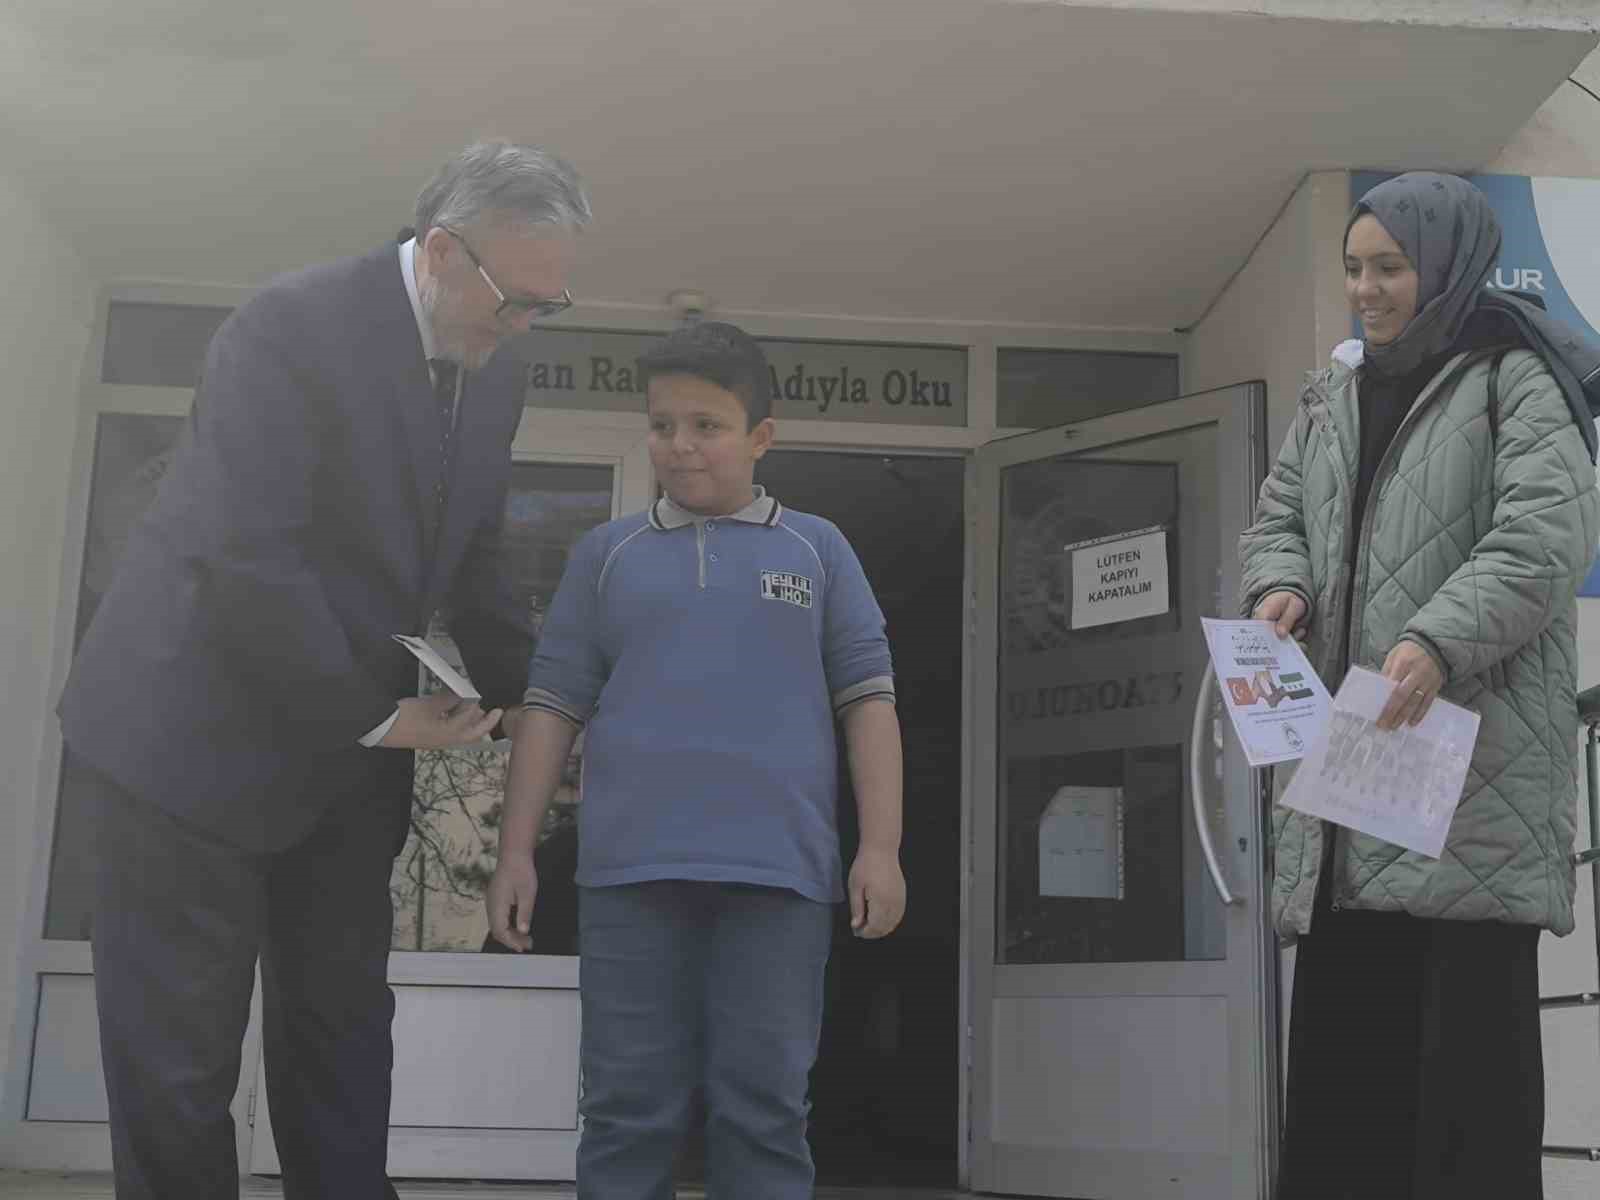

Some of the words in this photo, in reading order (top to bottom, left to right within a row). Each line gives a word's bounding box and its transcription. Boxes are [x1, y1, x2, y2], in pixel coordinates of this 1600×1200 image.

[1486, 267, 1546, 290] UR
[882, 369, 952, 408] Oku
[1088, 580, 1152, 603] KAPATALIM
